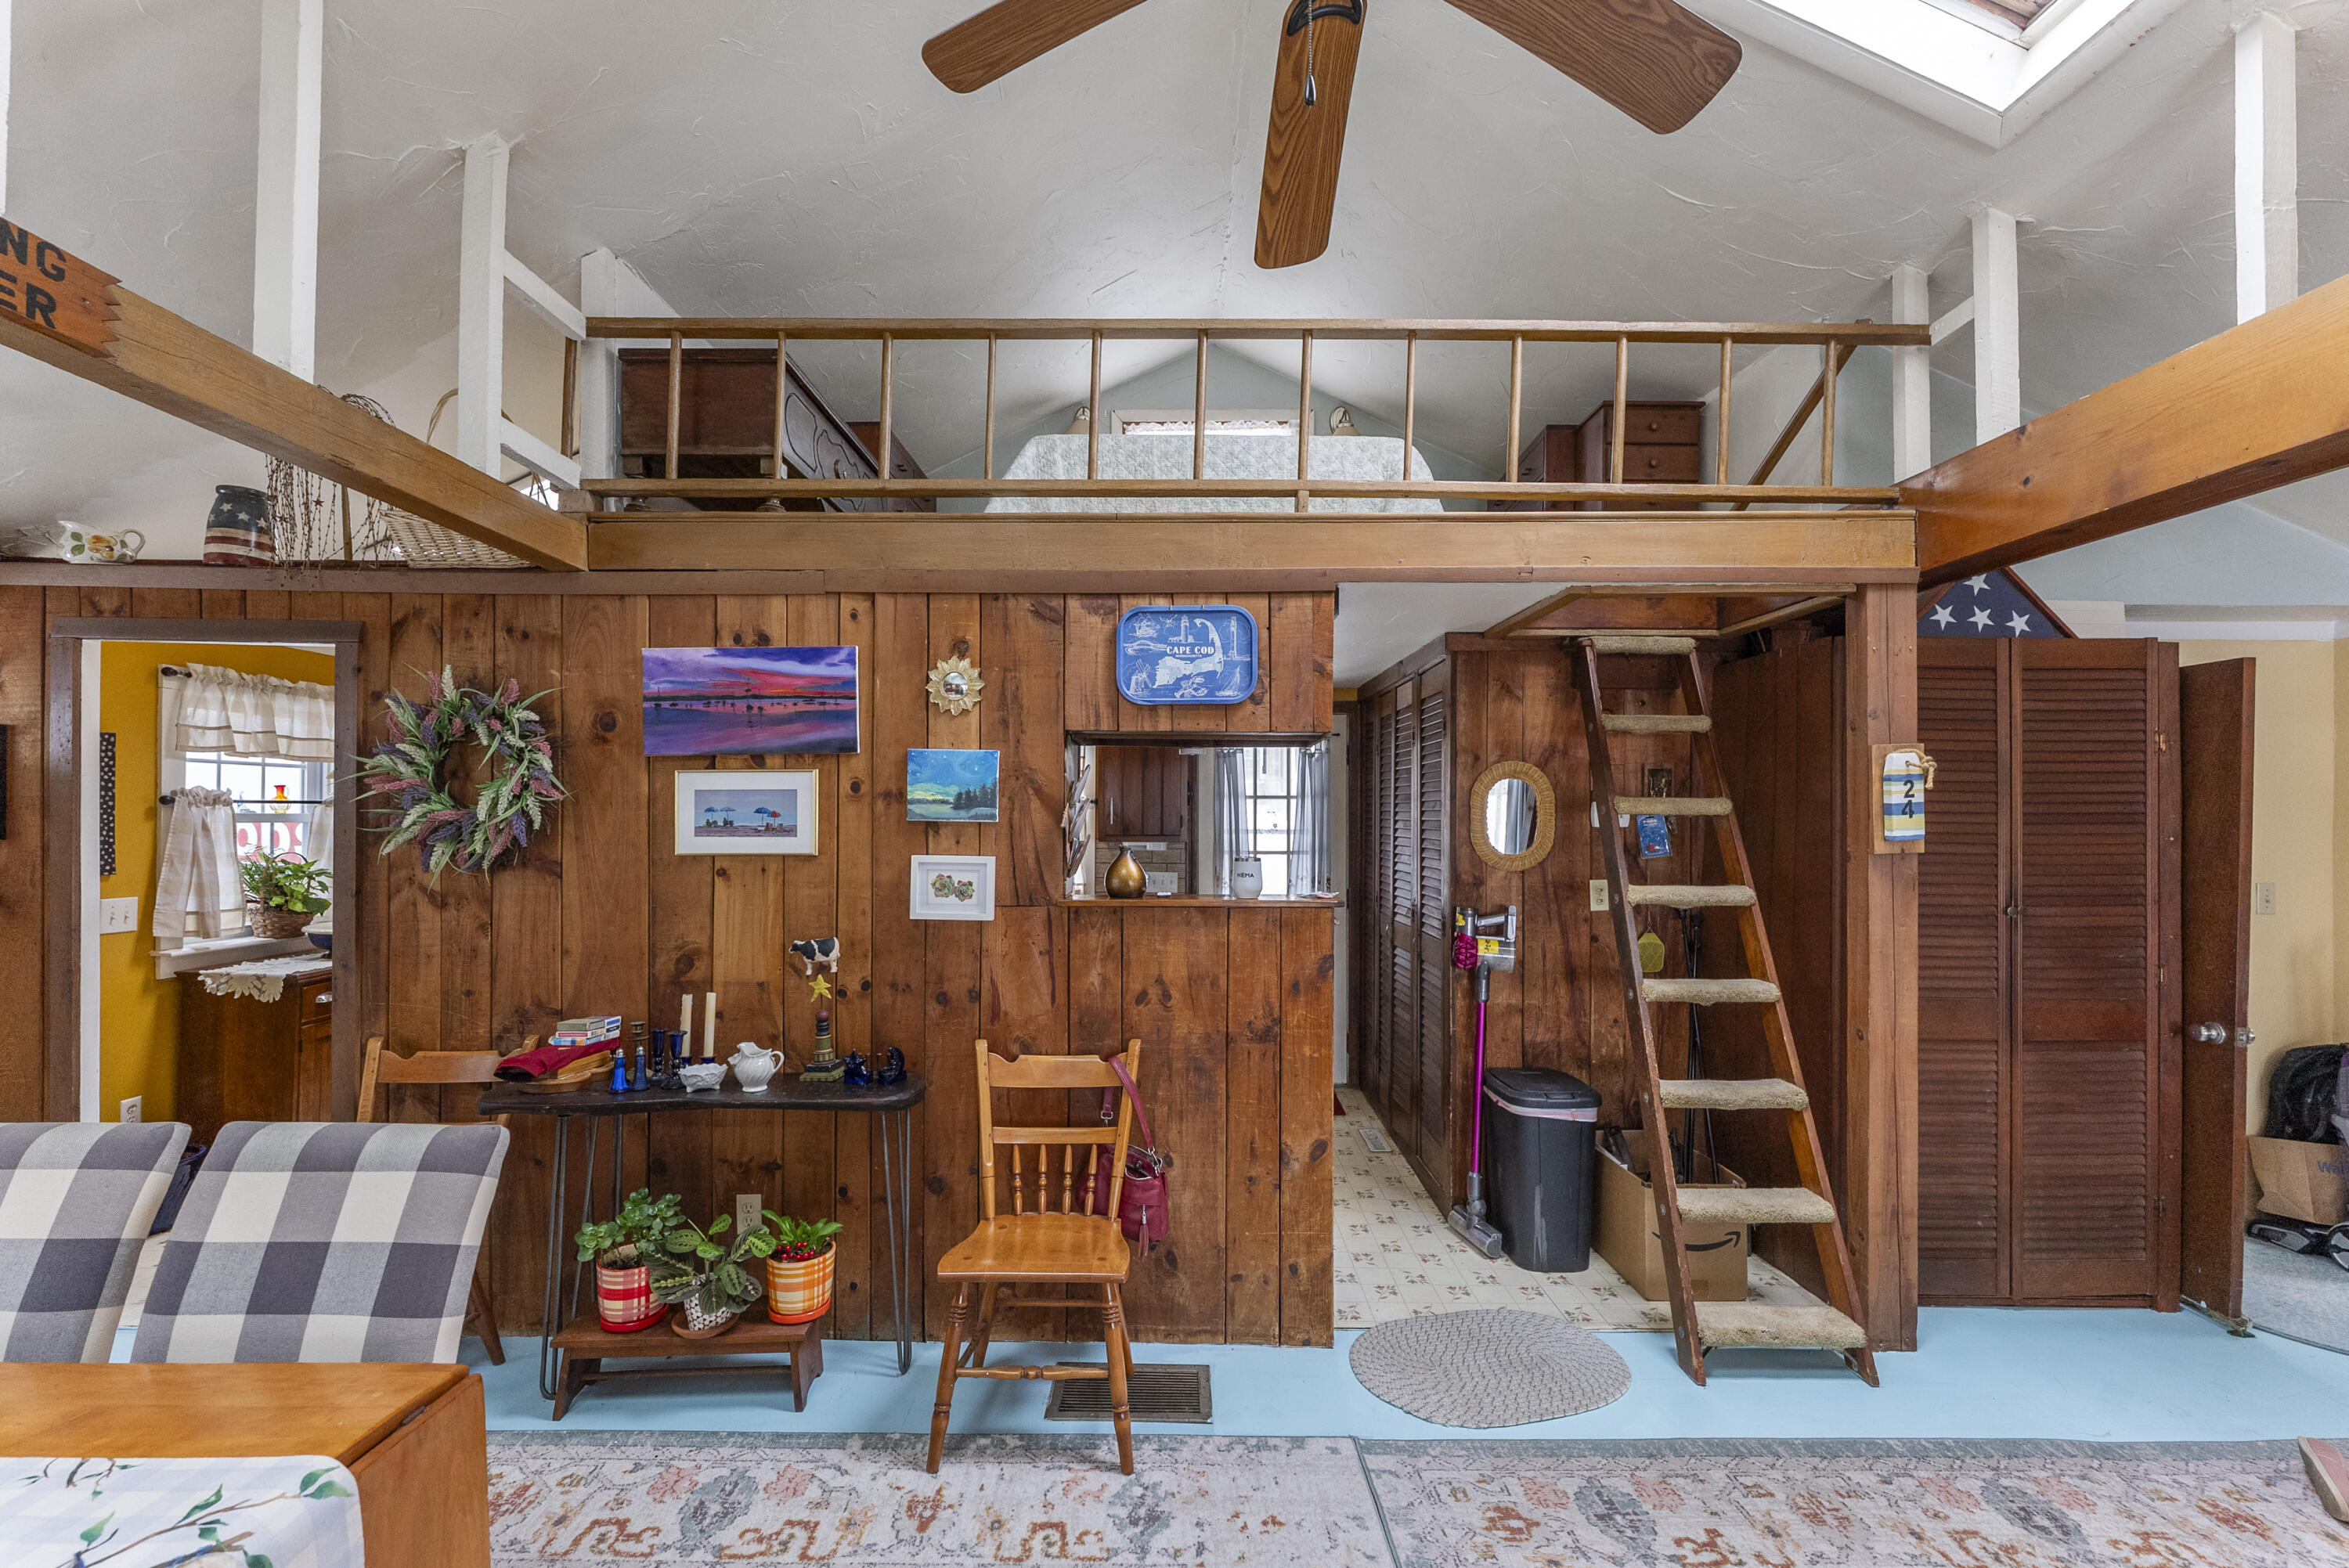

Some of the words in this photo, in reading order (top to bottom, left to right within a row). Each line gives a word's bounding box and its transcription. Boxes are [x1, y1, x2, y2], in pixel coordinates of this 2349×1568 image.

[0, 217, 67, 282] NG
[0, 269, 56, 329] ER
[1167, 646, 1192, 654] CAPE
[1194, 646, 1214, 654] COD
